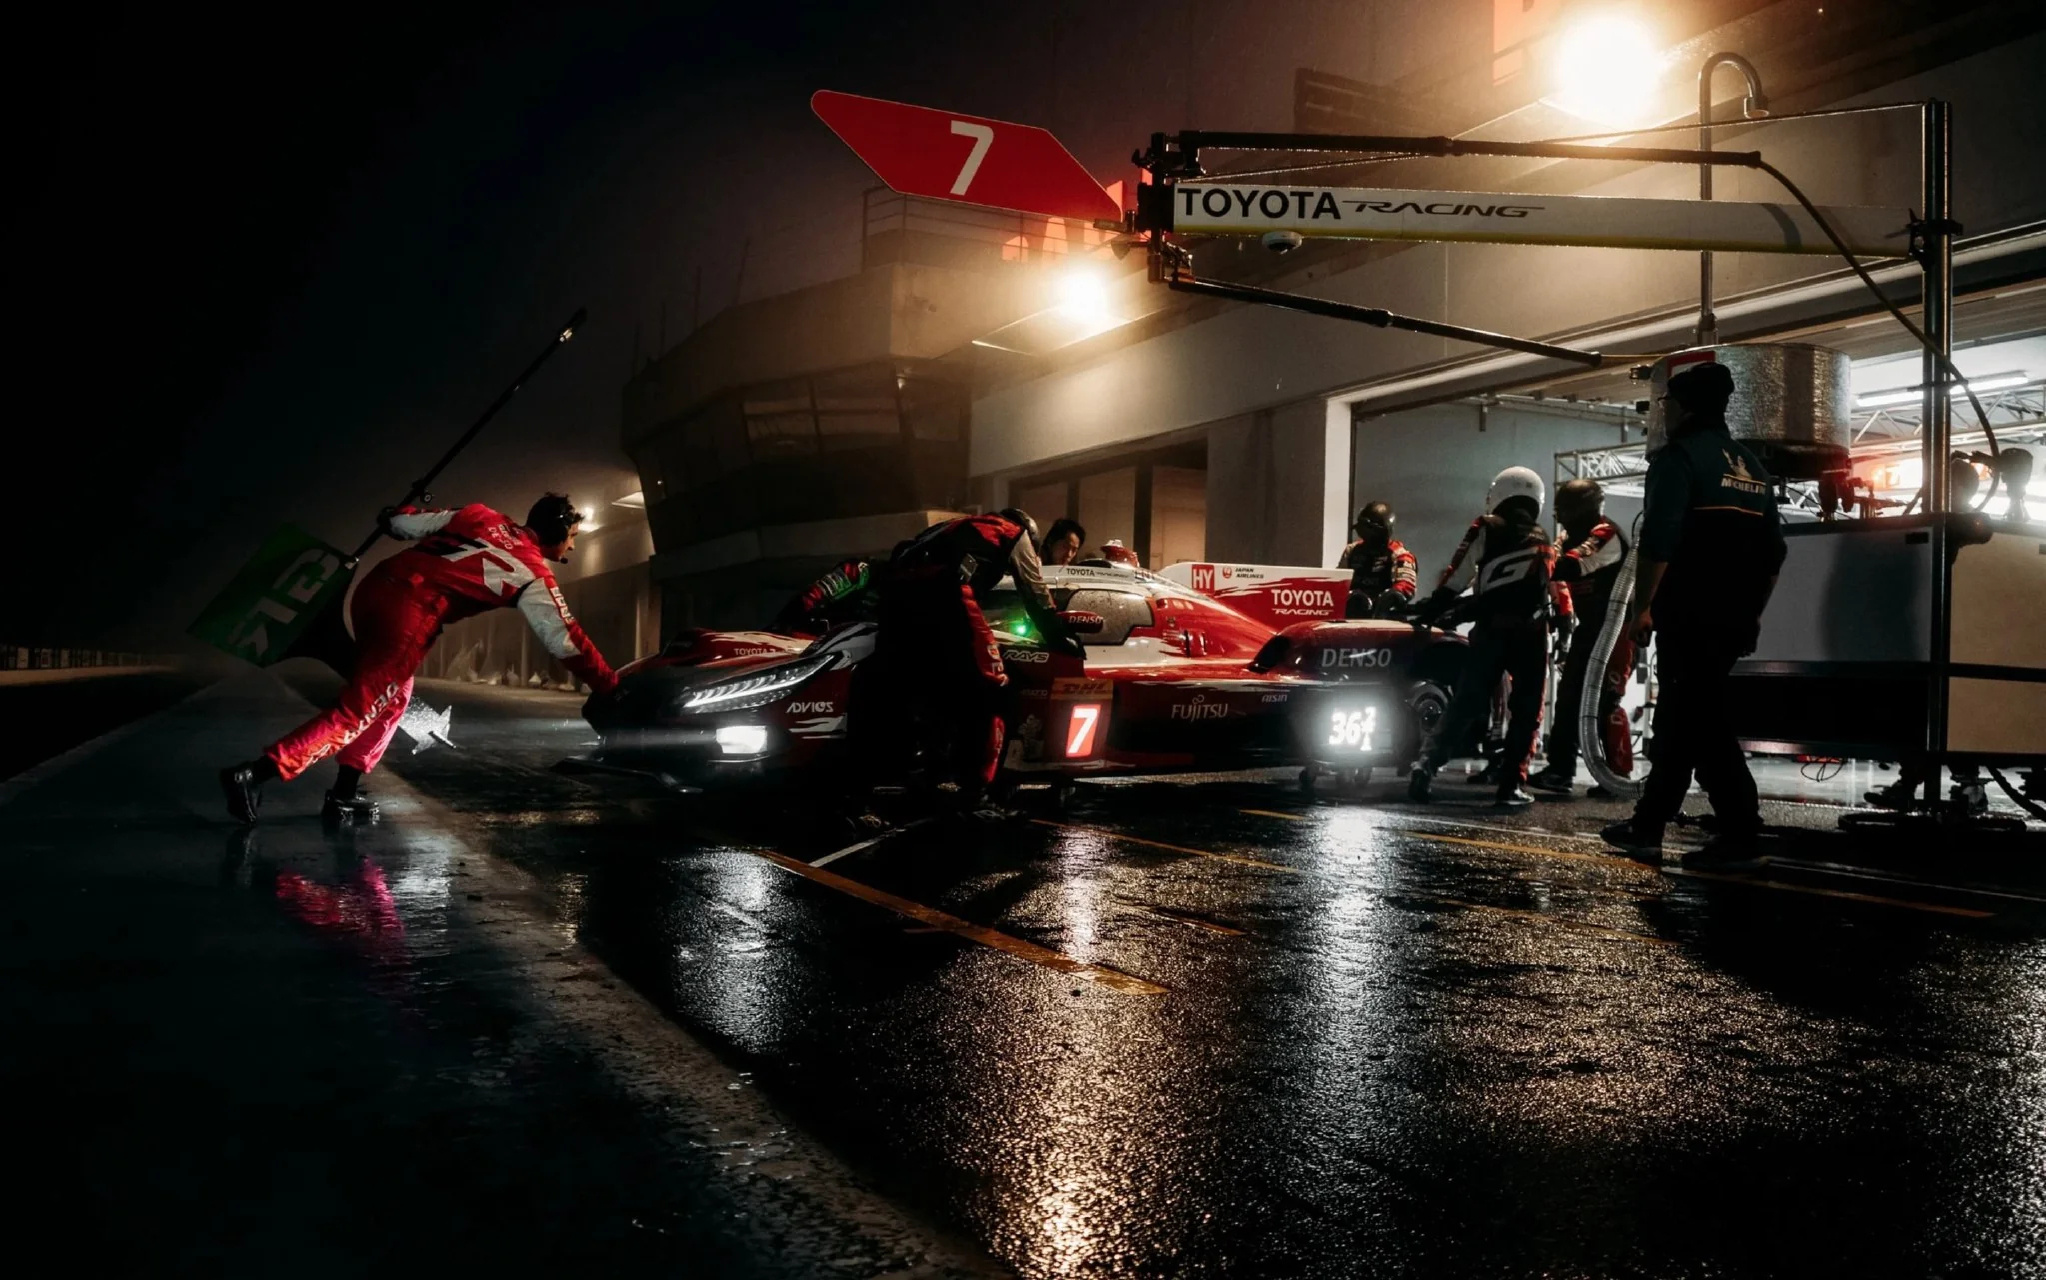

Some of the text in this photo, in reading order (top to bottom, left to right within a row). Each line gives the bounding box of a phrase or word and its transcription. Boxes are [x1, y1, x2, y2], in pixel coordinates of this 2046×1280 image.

[949, 119, 995, 197] 7
[1177, 188, 1545, 219] TOYOTA RACING
[1066, 568, 1095, 577] TOYOTA
[1193, 567, 1213, 590] HY
[1271, 589, 1335, 607] TOYOTA
[1068, 615, 1104, 625] DENSO
[1271, 608, 1335, 617] RACING
[733, 648, 767, 656] TOYOTA
[1003, 649, 1050, 663] RAYS
[1321, 648, 1392, 668] DENSO
[1171, 700, 1229, 723] FUJITSU
[1066, 707, 1099, 755] 7
